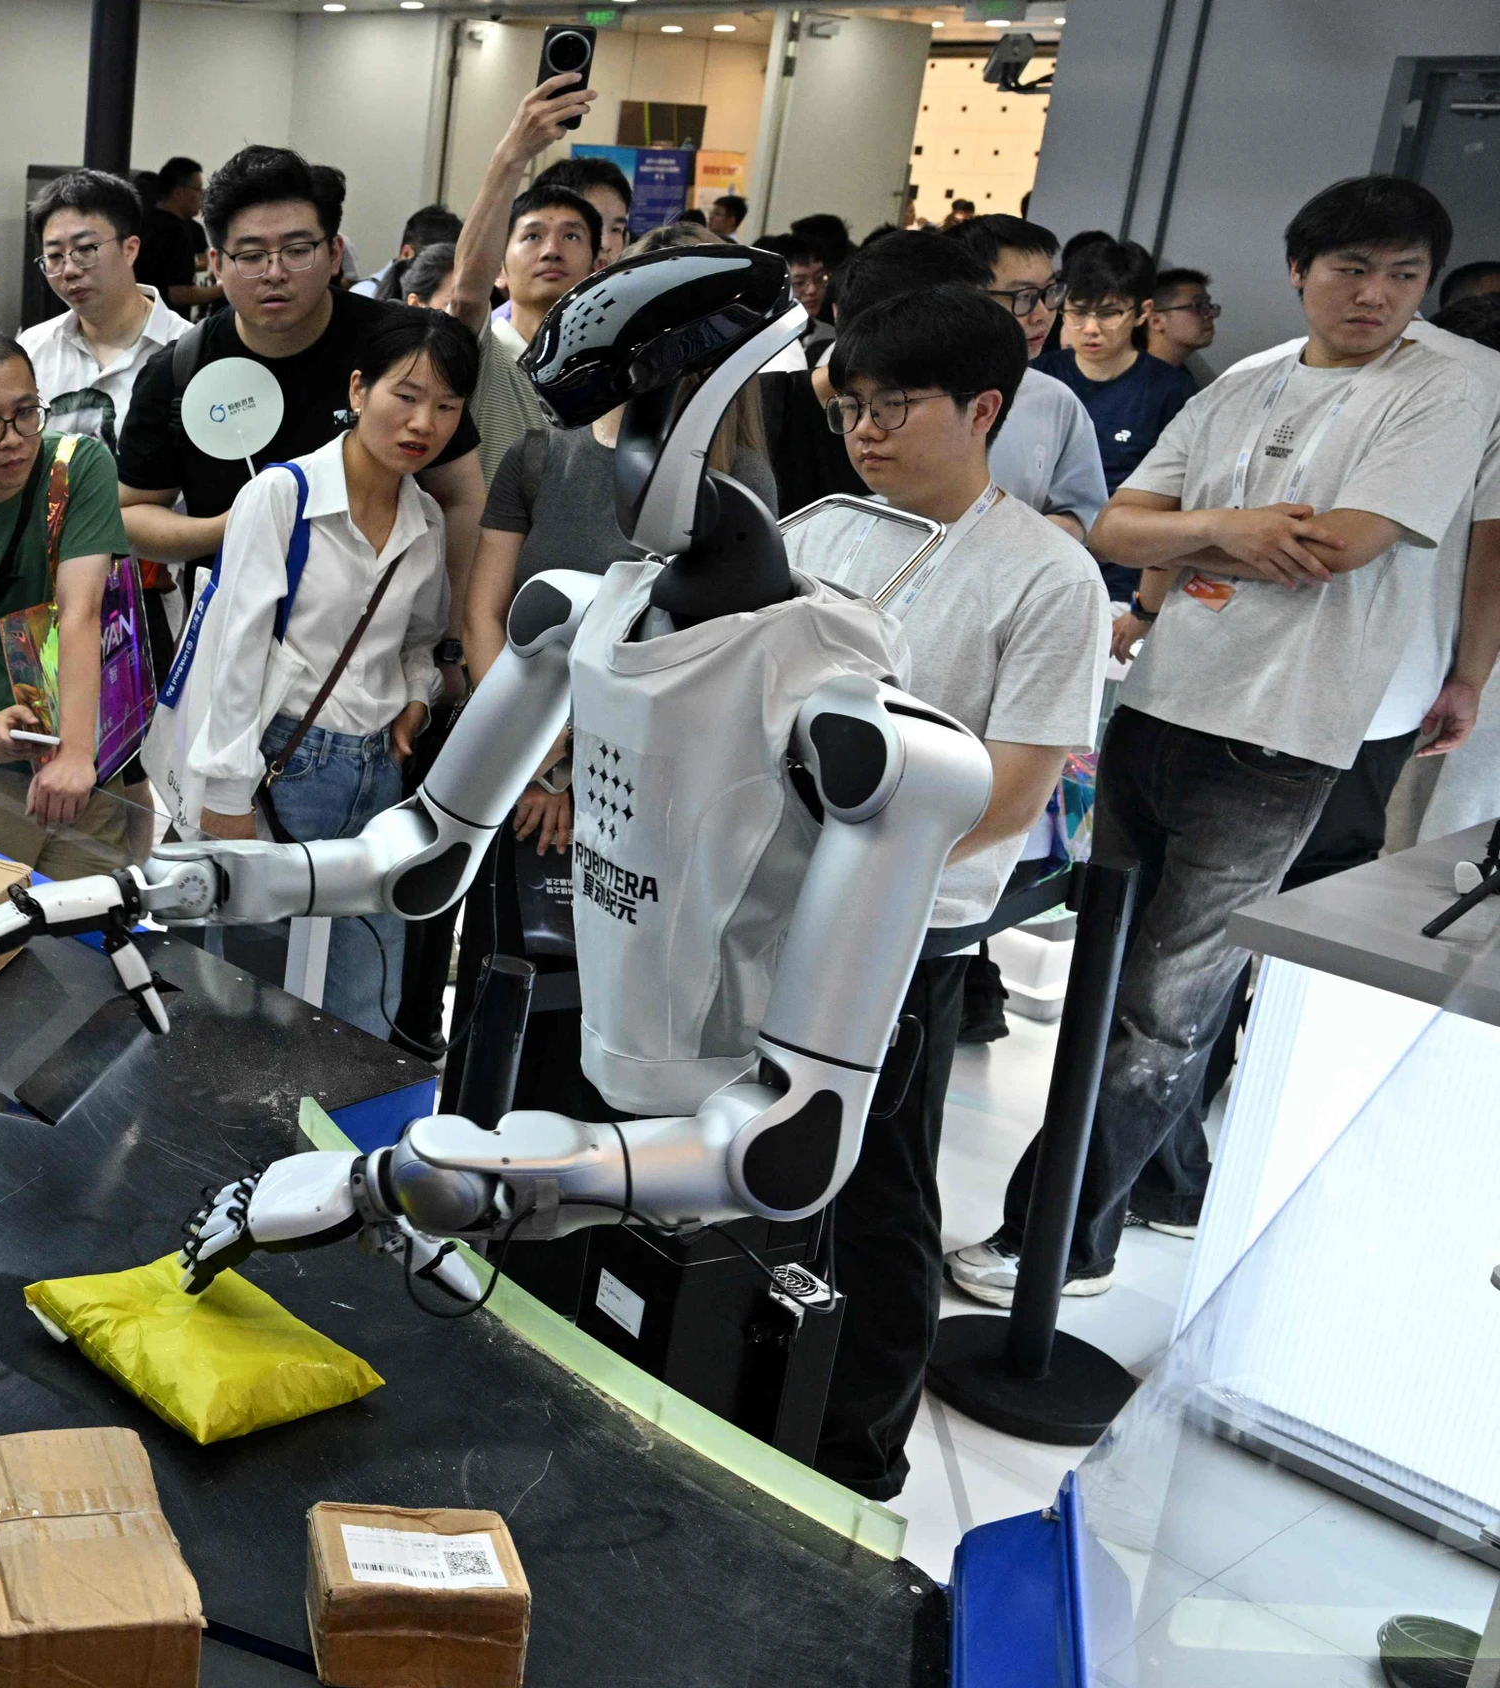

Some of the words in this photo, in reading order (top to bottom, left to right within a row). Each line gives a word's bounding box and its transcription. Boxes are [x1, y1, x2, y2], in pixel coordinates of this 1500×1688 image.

[229, 407, 241, 416] ANT
[171, 650, 190, 687] LinkSoul
[575, 841, 659, 902] ROBOTERA
[583, 871, 637, 925] 星动纪元
